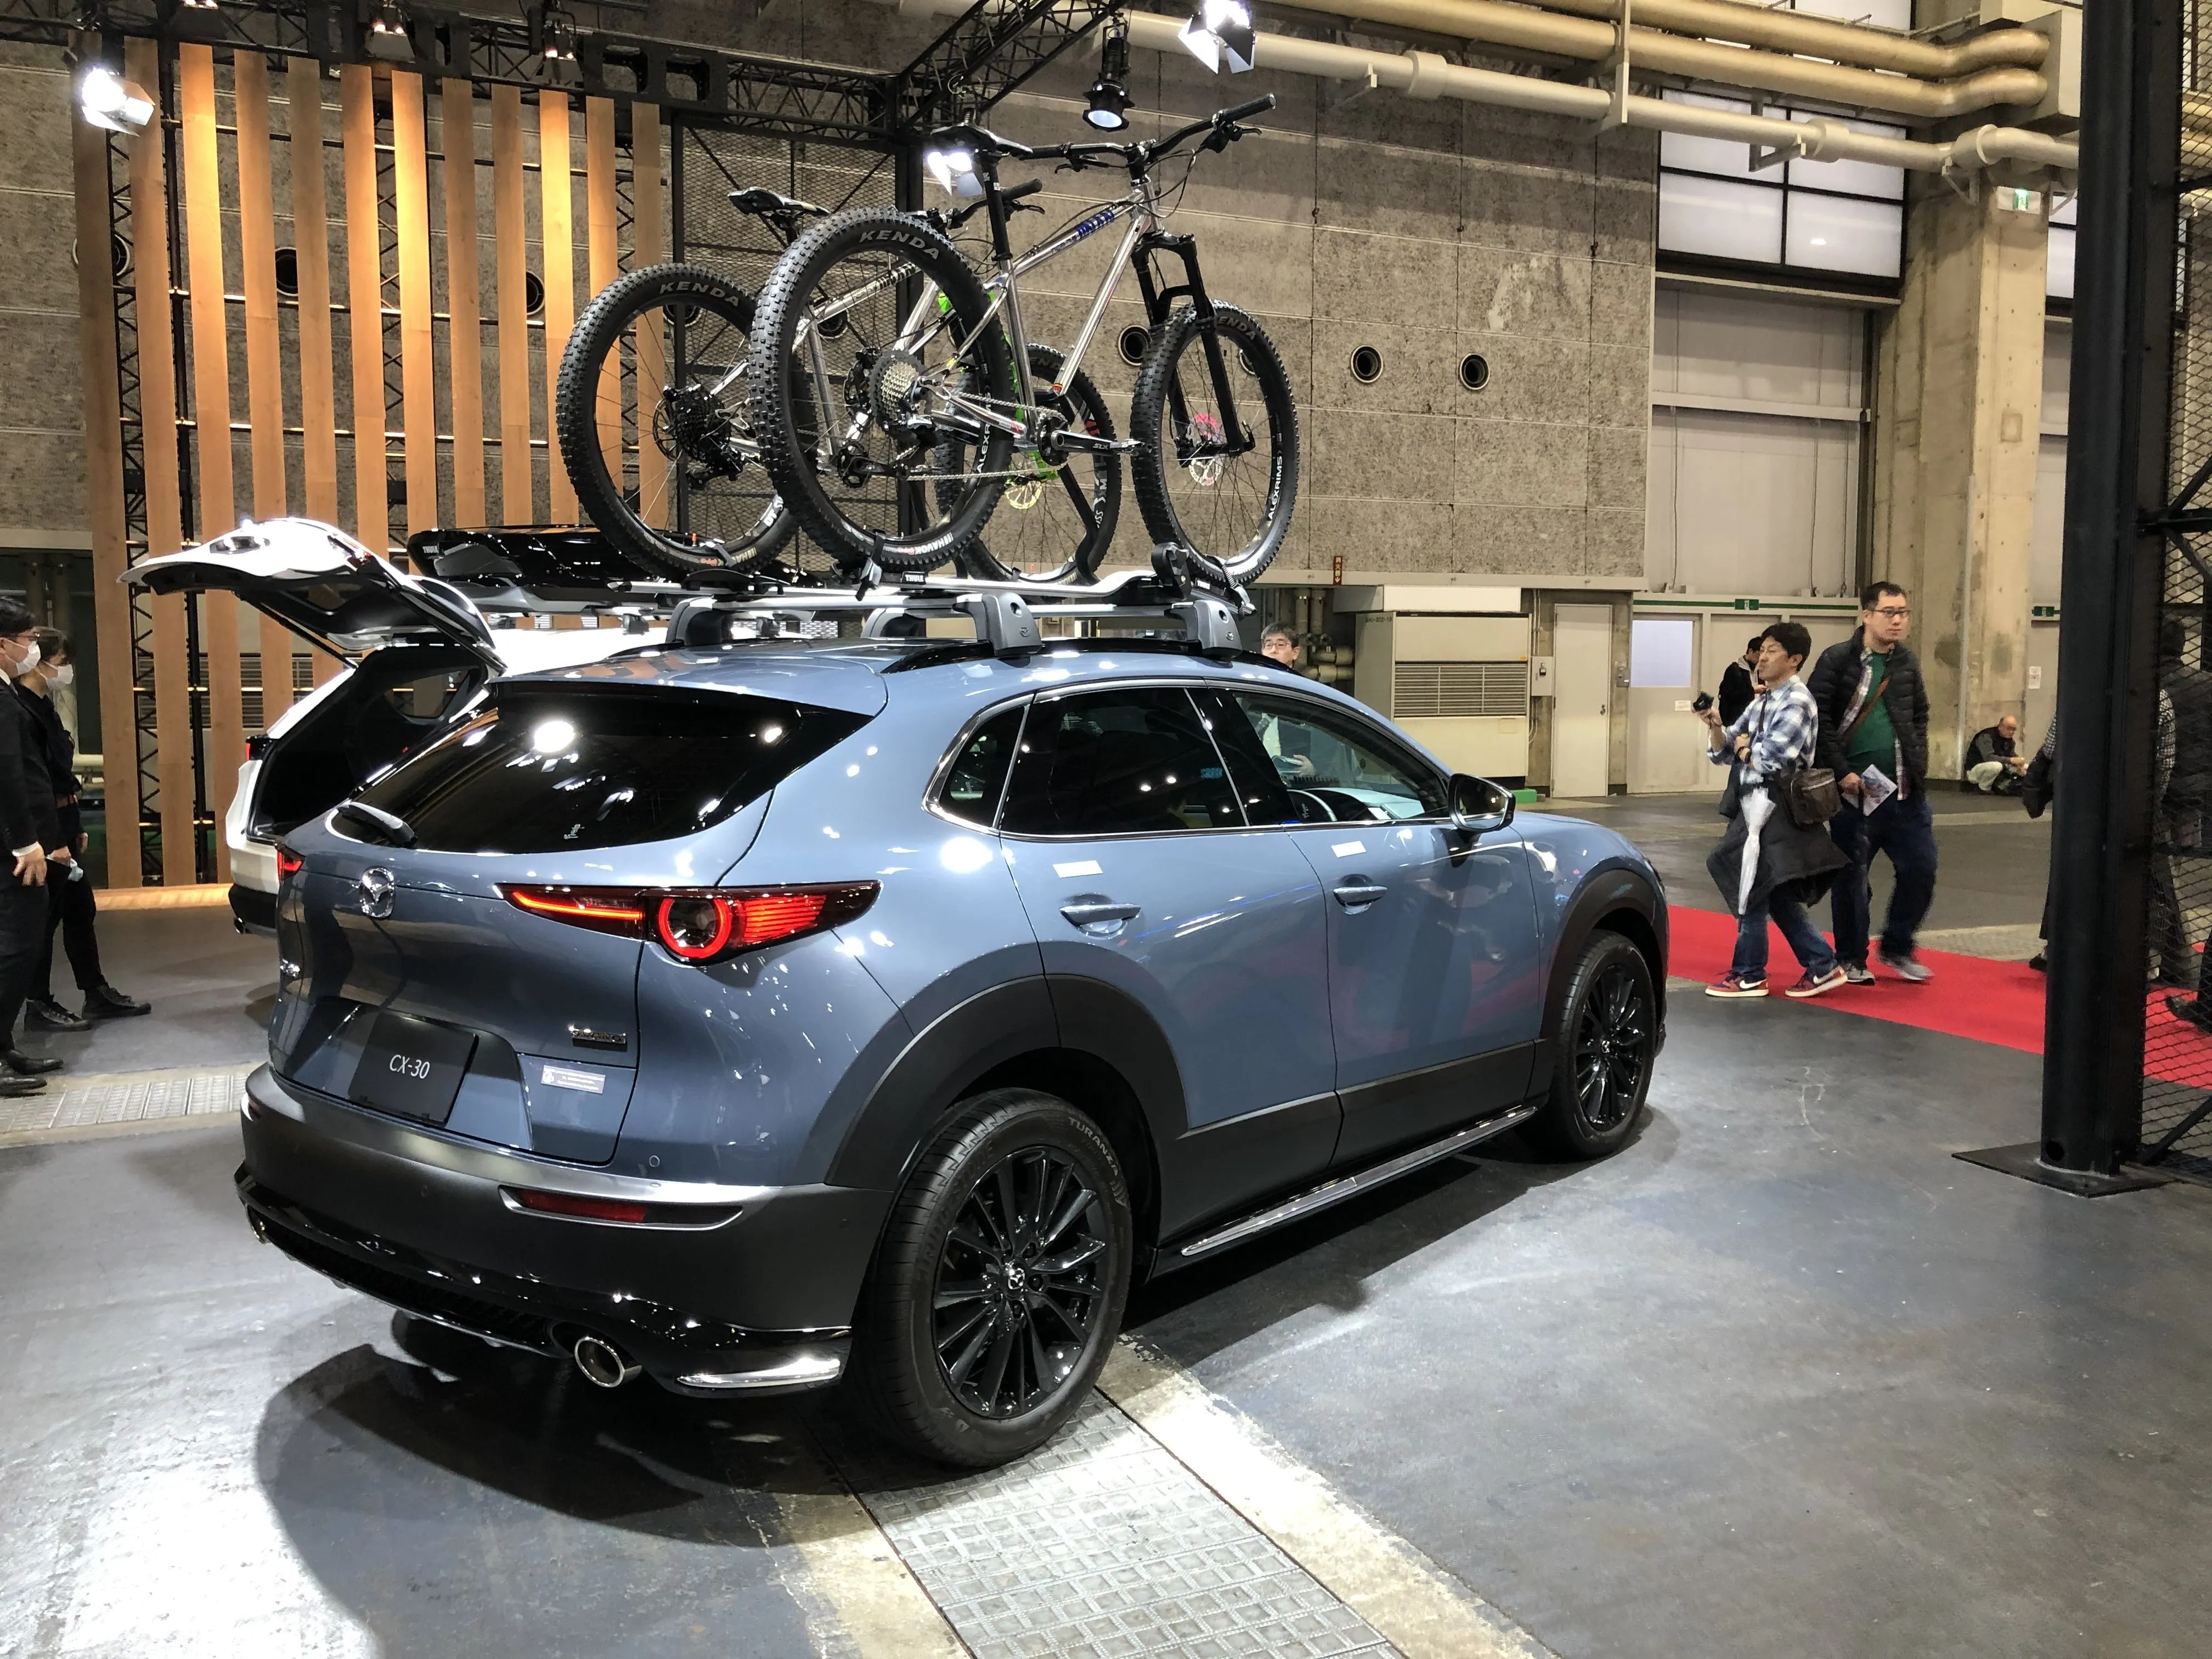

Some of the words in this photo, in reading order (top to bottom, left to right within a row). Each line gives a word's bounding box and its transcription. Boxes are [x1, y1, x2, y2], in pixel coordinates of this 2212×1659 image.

[859, 230, 939, 260] KENDA
[659, 281, 739, 307] KENDA
[1217, 316, 1256, 340] ENDA
[1268, 455, 1283, 520] ALEXRIMS
[390, 1054, 430, 1079] CX-30
[1068, 1116, 1118, 1176] TURANZA
